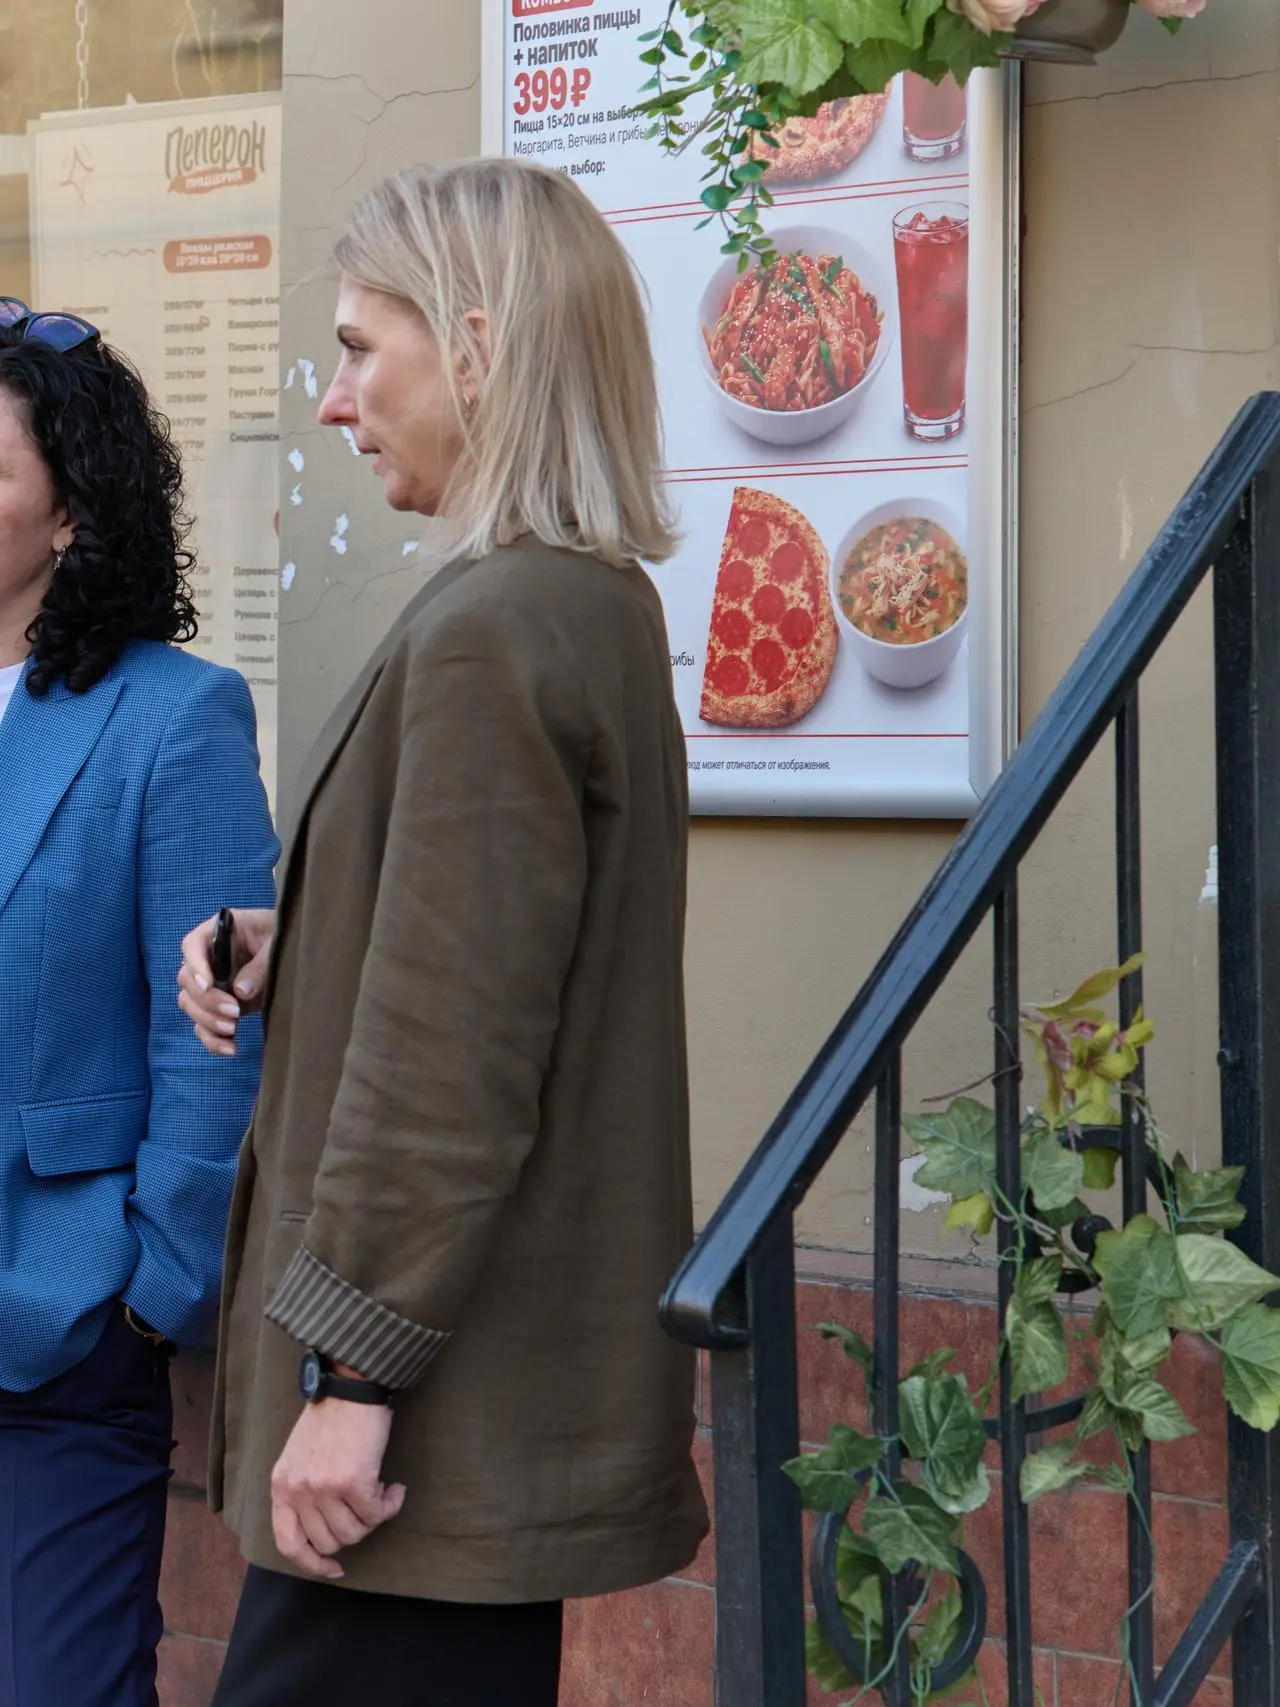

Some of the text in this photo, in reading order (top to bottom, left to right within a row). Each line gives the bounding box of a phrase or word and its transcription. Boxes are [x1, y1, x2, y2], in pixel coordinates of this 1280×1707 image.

[513, 8, 641, 42] Половинка пиццы
[513, 38, 598, 67] + напиток
[513, 66, 591, 115] 399₽
[513, 118, 544, 135] Пицца
[577, 113, 591, 125] см
[592, 111, 604, 124] на
[513, 139, 566, 158] Маргарита,
[568, 131, 607, 149] Ветчина
[609, 131, 616, 144] и
[570, 159, 606, 176] выбор:
[701, 760, 725, 770] может
[725, 760, 767, 770] отличаться
[767, 760, 777, 770] от
